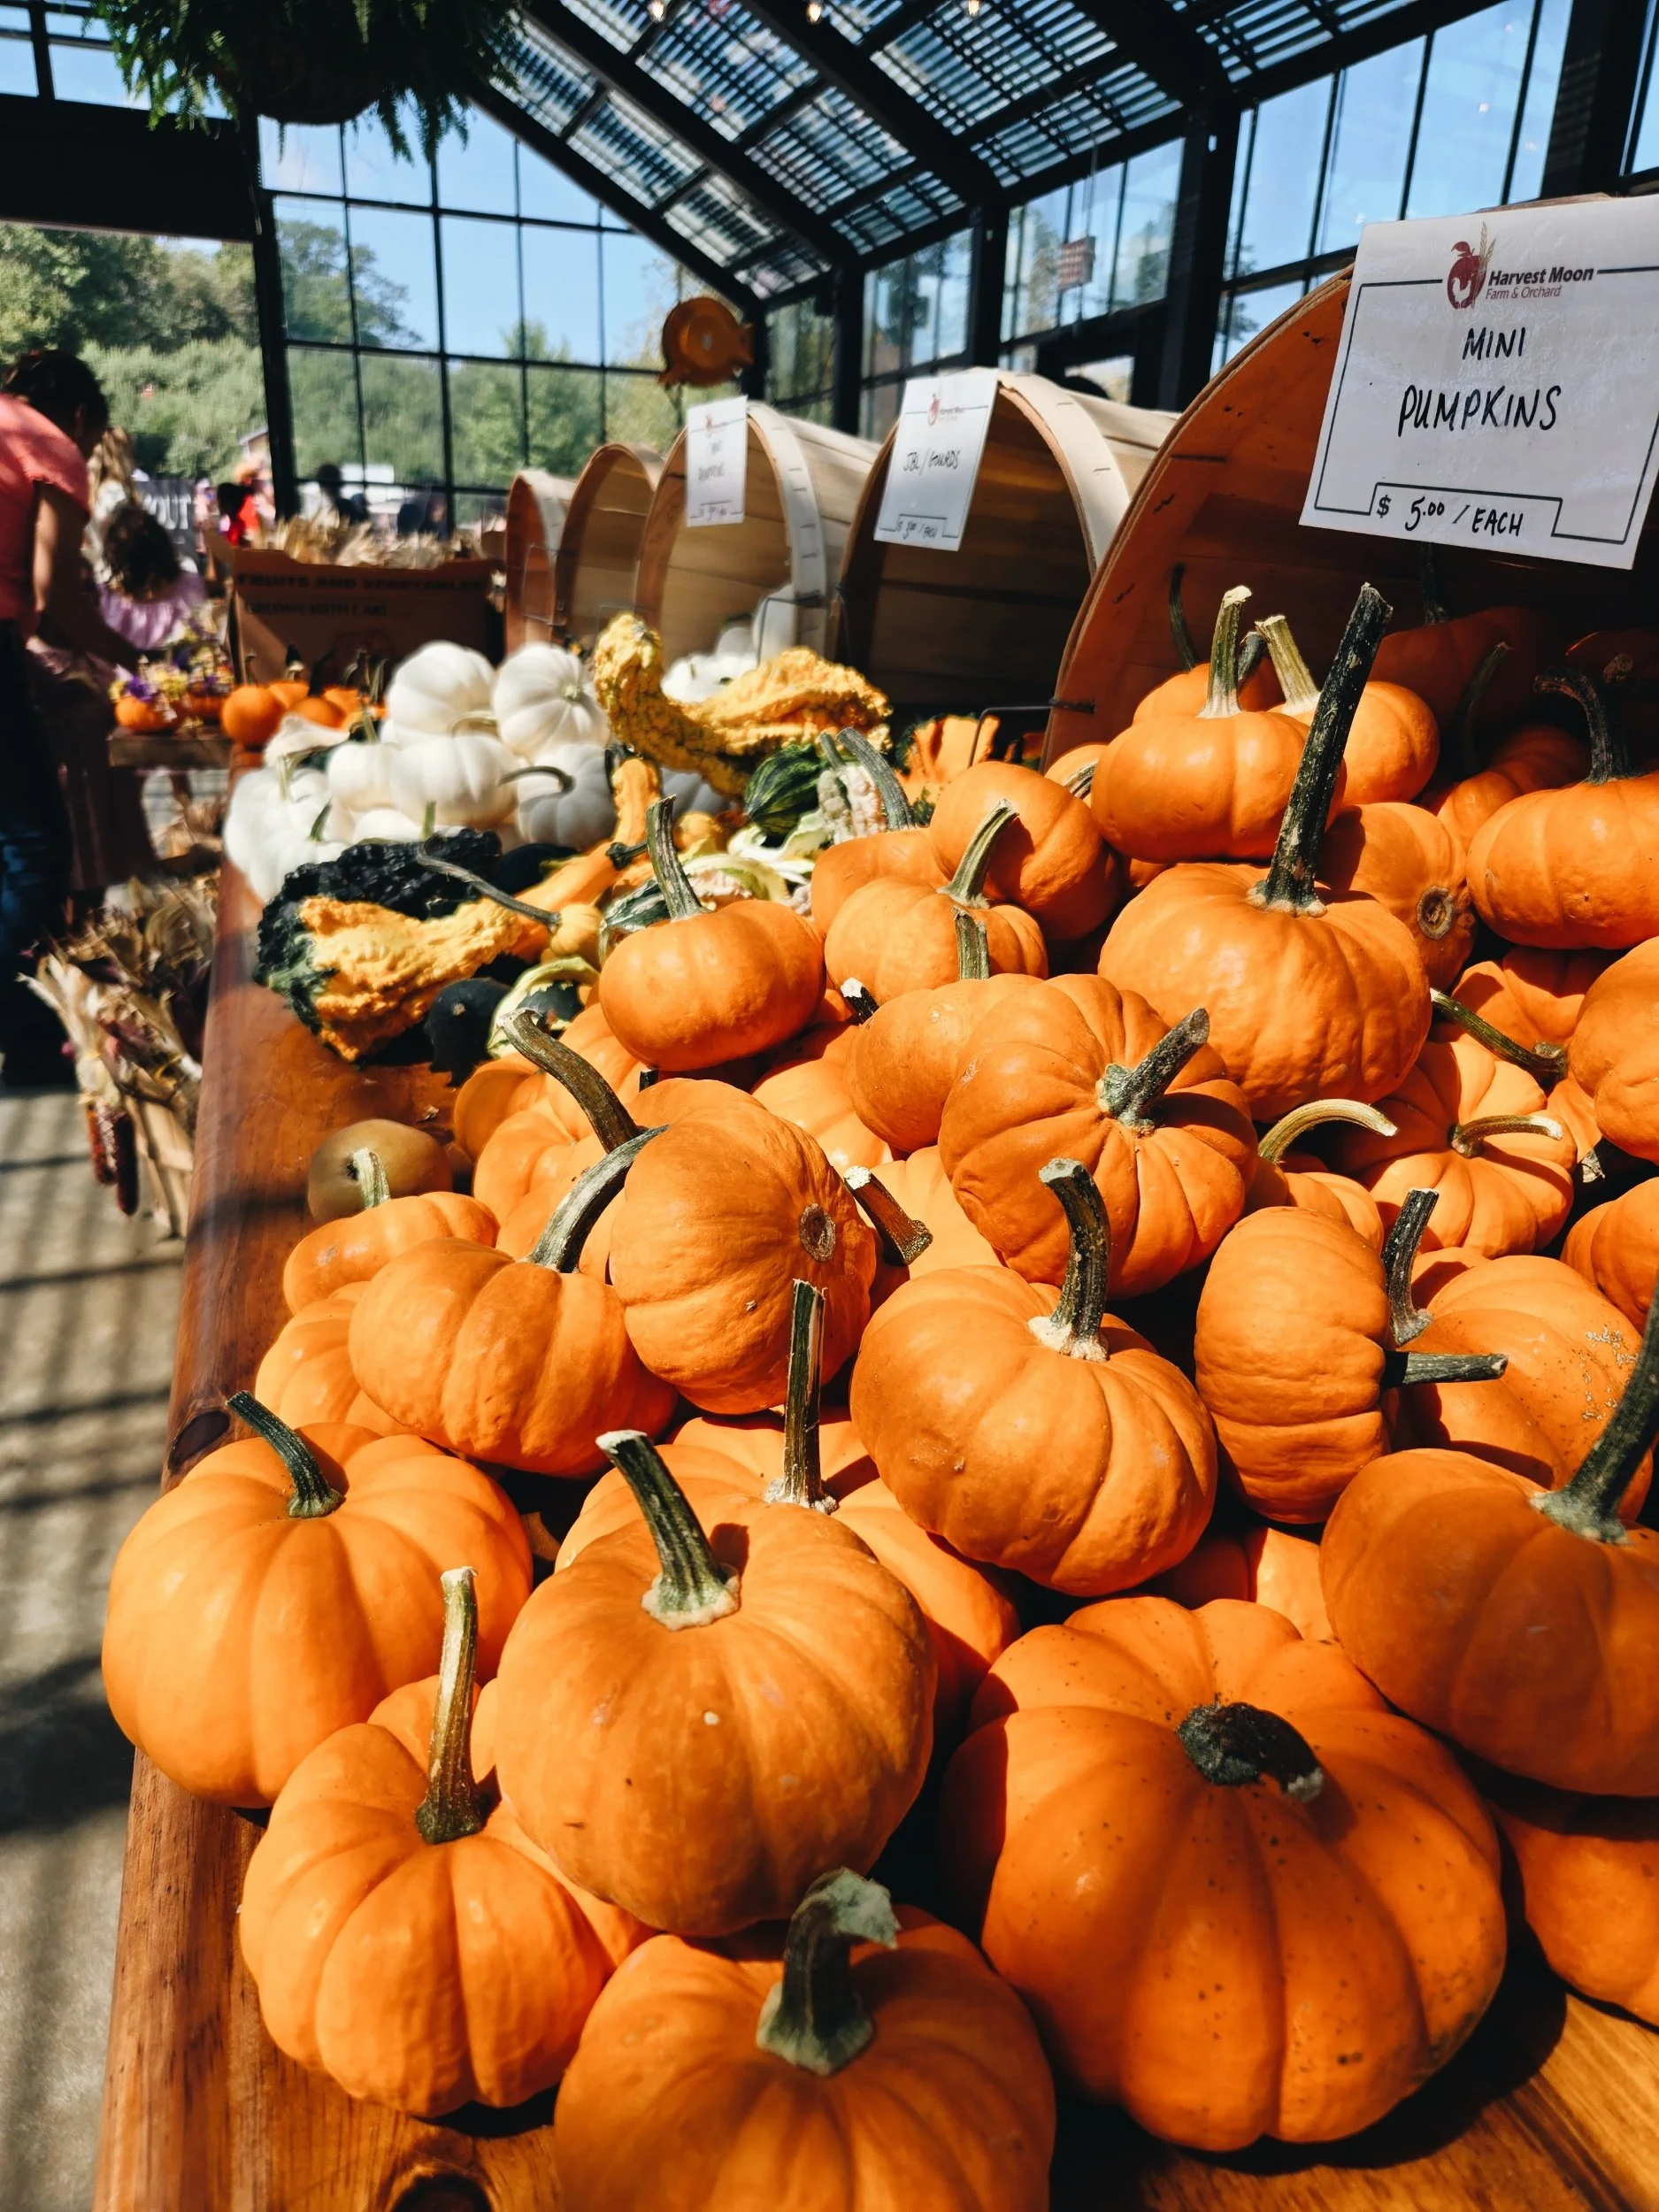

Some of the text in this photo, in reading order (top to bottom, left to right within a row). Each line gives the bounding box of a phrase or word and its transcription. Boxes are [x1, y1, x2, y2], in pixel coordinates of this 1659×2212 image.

[1488, 266, 1594, 286] Harvest Moon
[1486, 285, 1562, 300] Farm & Orchard
[1462, 326, 1526, 361] MINI
[1397, 384, 1562, 438] PUMPKINS
[1376, 495, 1392, 518] $
[1404, 495, 1445, 532] 5.00
[1471, 507, 1524, 537] EACH
[237, 573, 484, 590] FRUITS AND VEGETABLES
